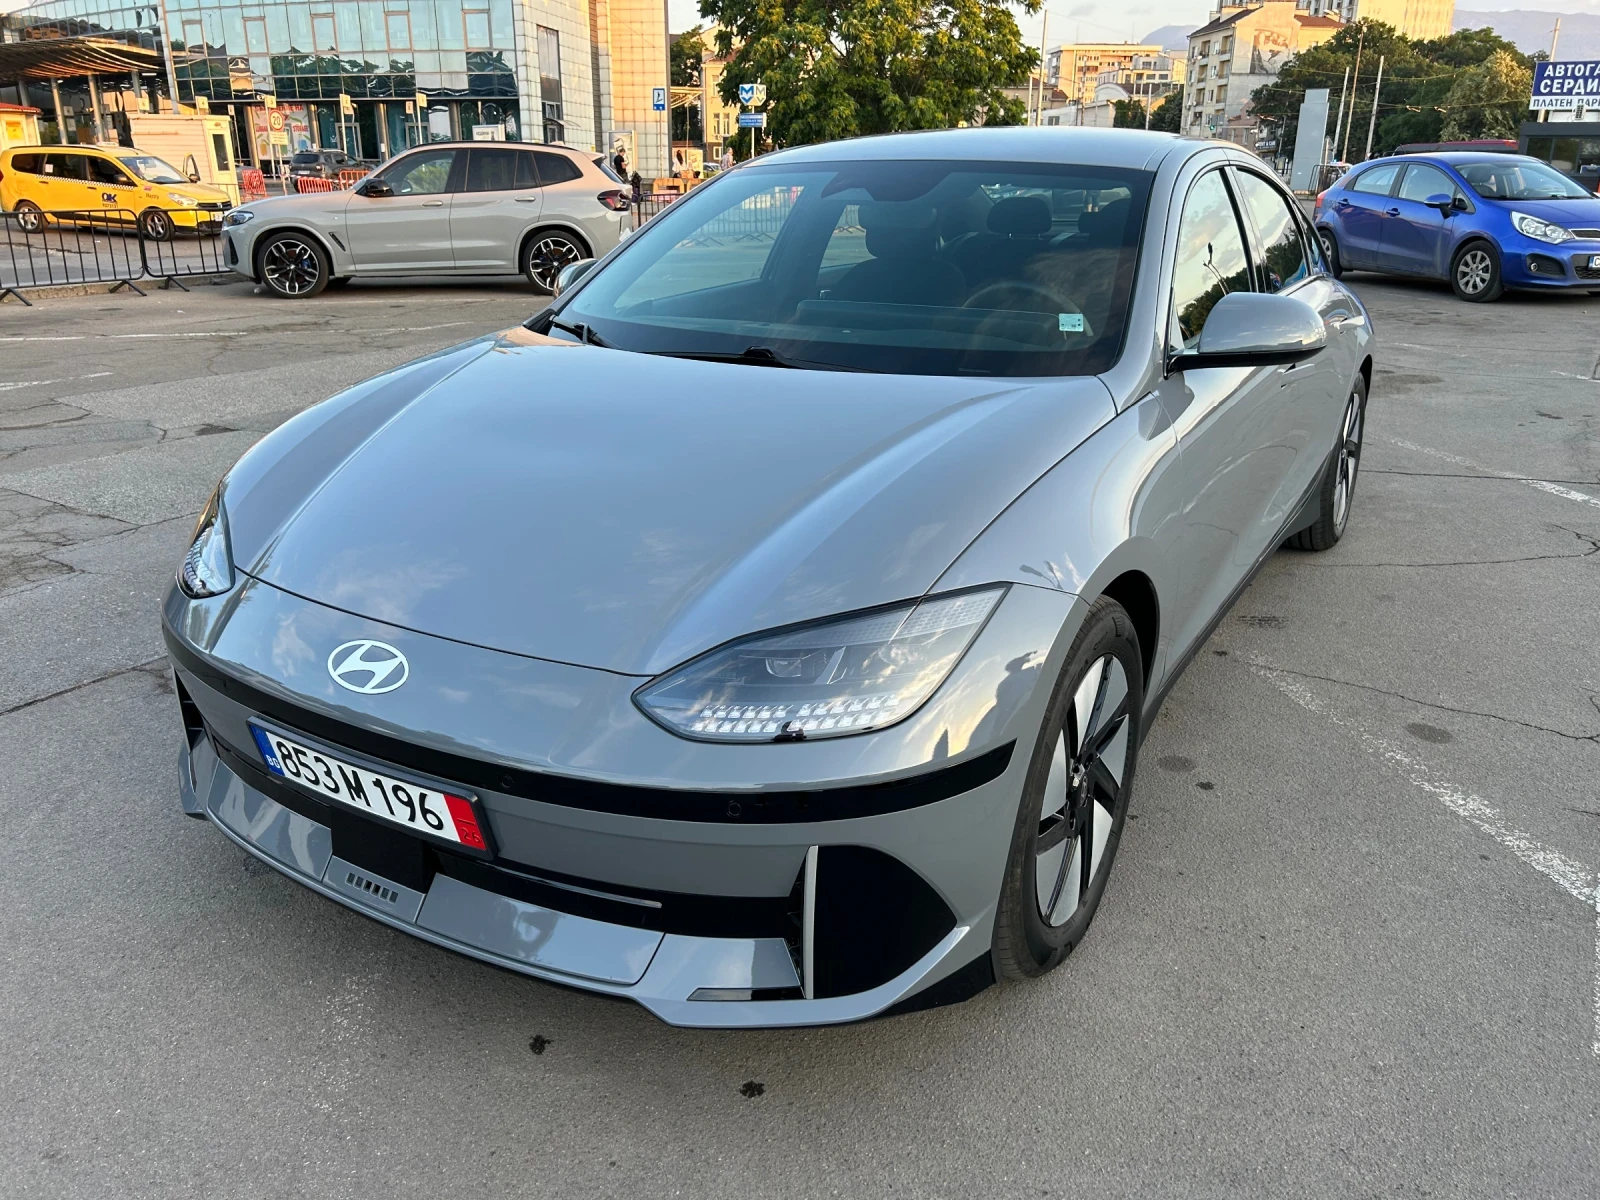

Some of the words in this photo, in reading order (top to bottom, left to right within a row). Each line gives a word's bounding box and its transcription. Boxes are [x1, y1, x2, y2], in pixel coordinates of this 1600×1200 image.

[1540, 78, 1600, 95] СЕРДИ
[1533, 99, 1572, 107] ПЛАТЕН
[272, 115, 281, 126] 20
[265, 754, 281, 769] BG
